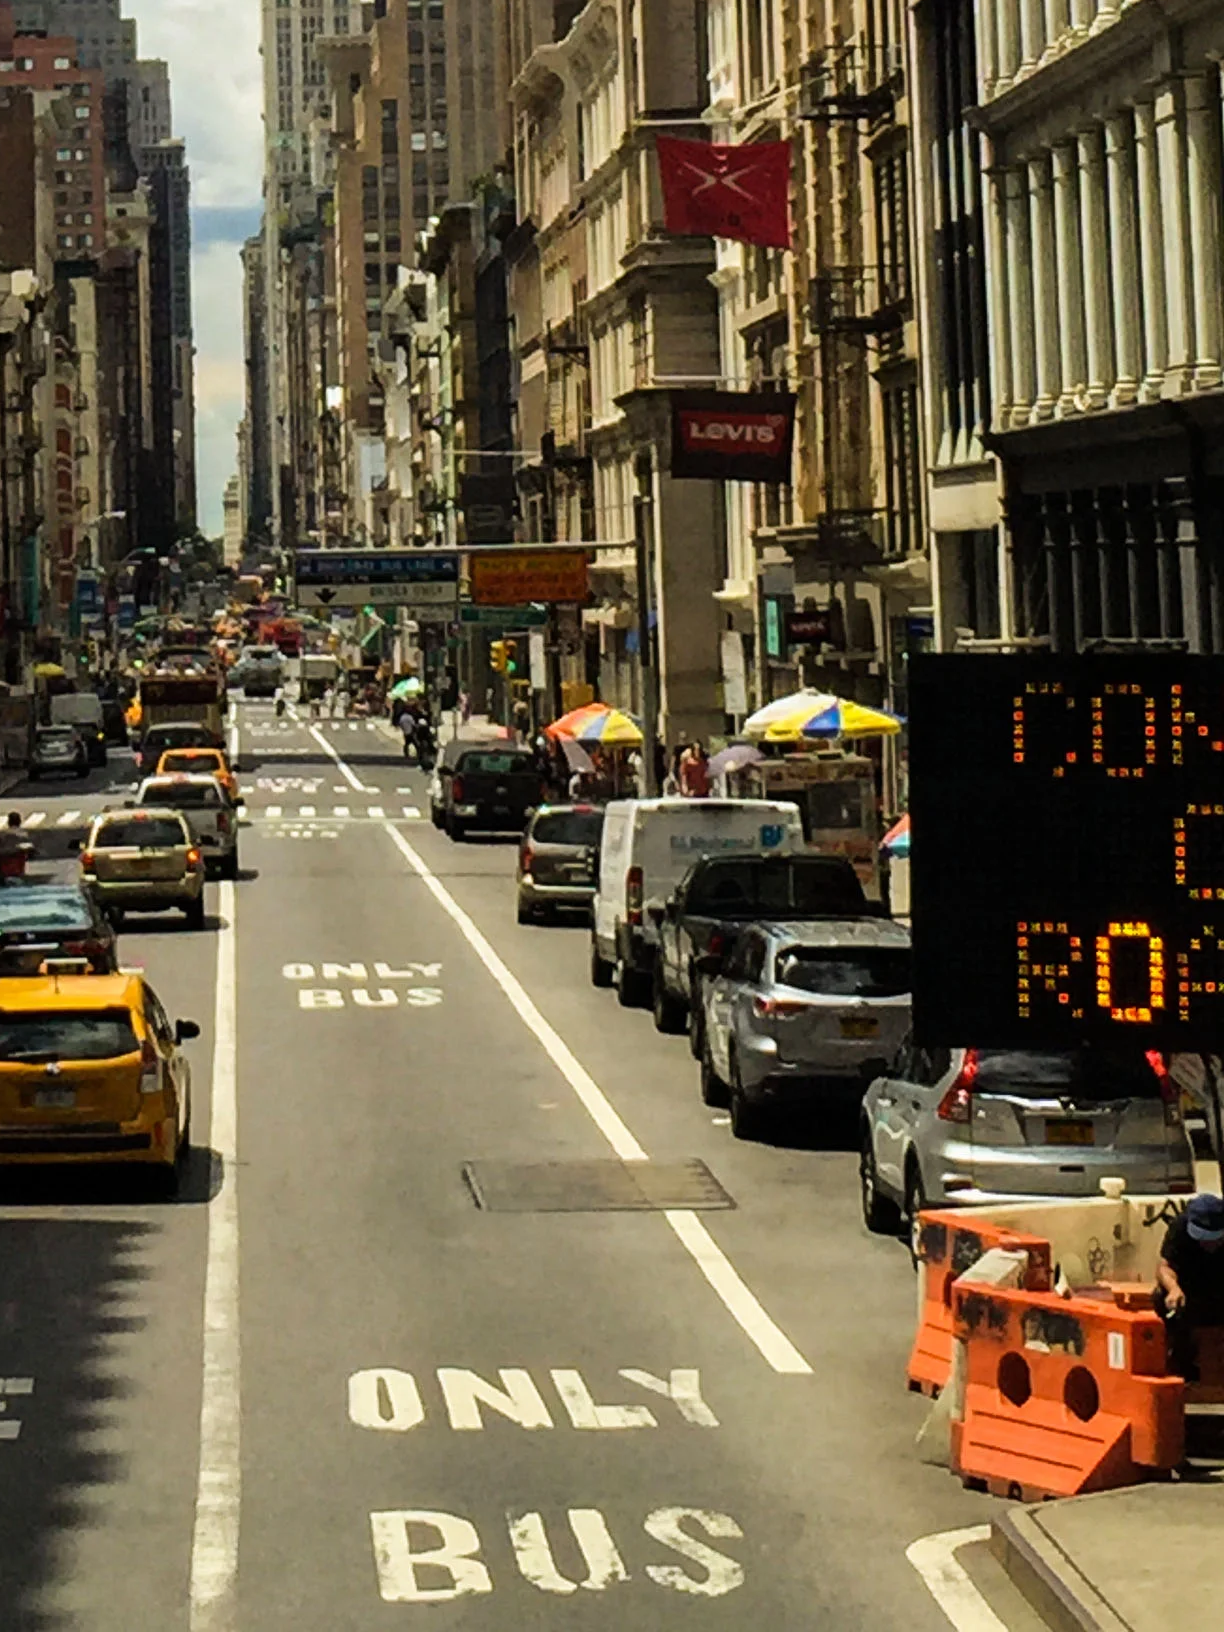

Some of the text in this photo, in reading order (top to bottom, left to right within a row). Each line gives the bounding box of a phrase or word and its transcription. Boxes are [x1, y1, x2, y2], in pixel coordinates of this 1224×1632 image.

[282, 962, 443, 980] ONLY
[298, 988, 444, 1009] BUS
[348, 1367, 720, 1432] ONLY
[369, 1505, 746, 1602] BUS
